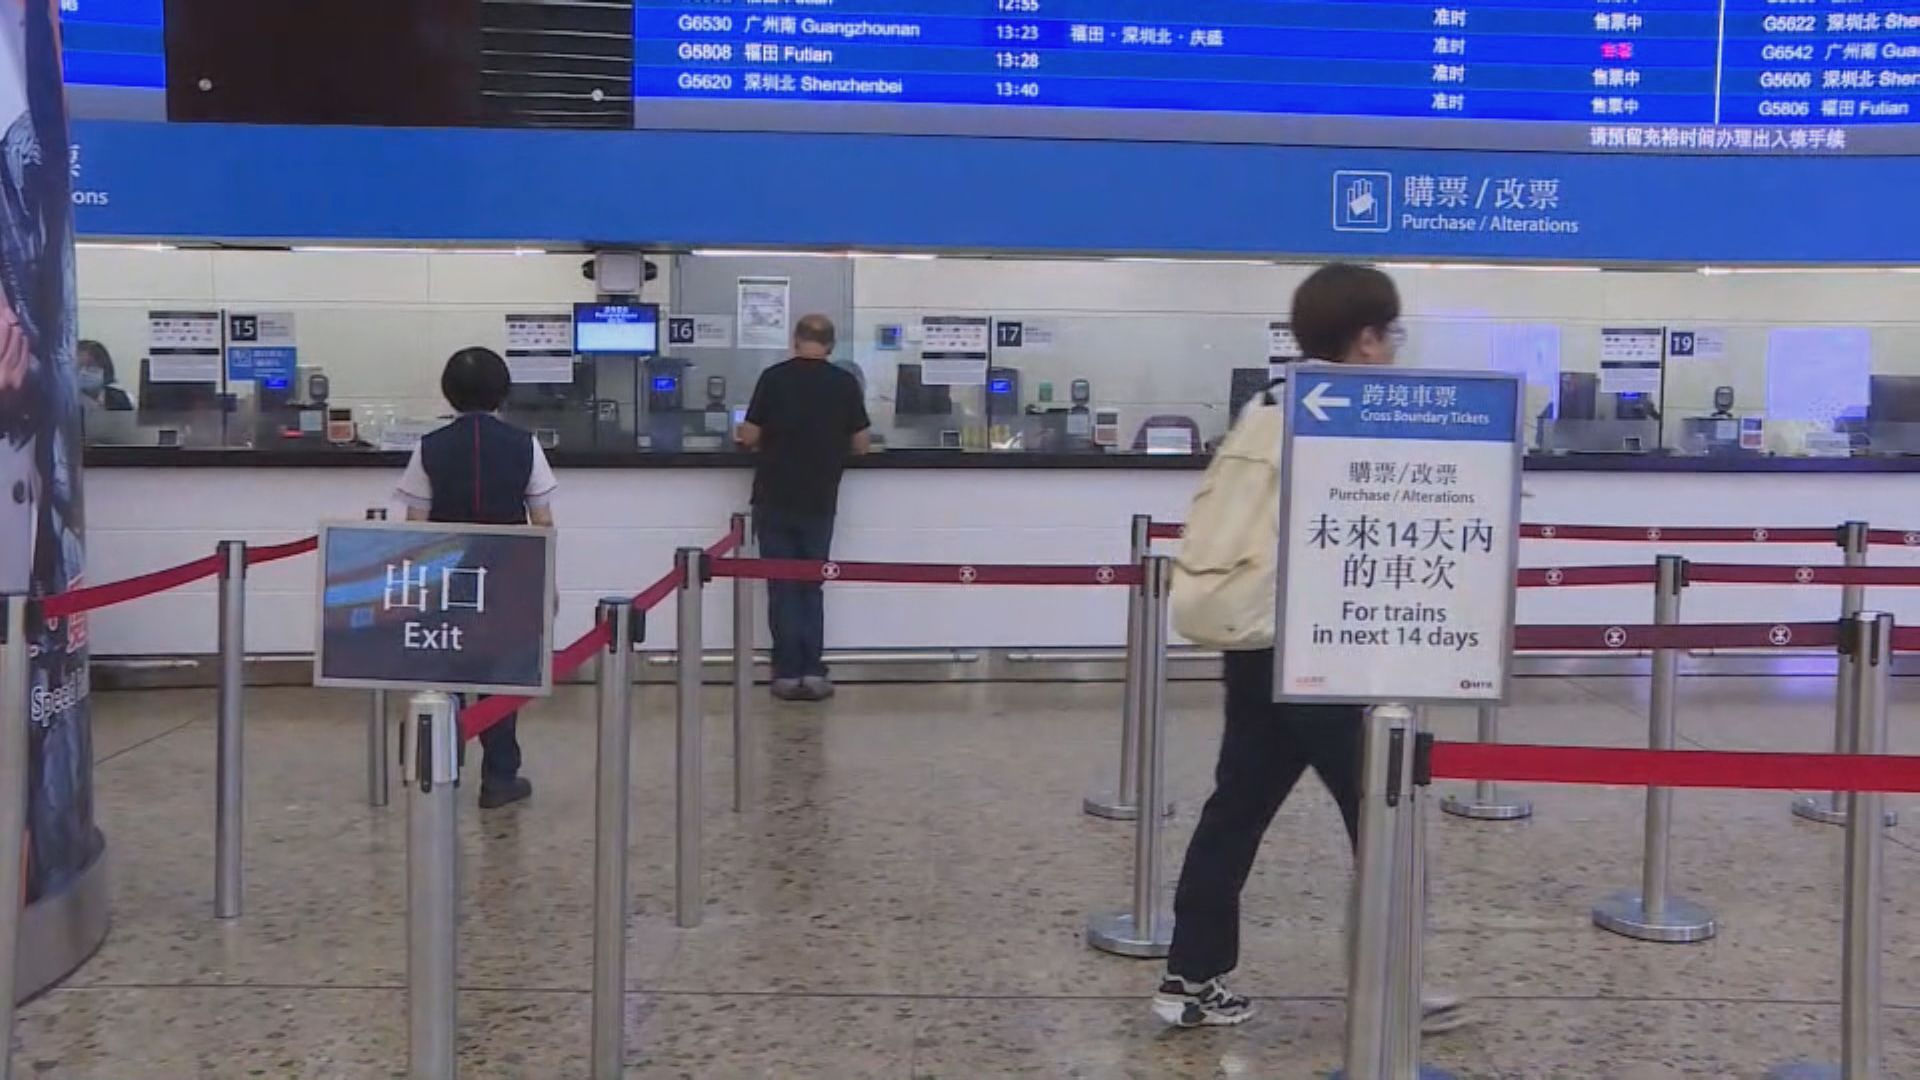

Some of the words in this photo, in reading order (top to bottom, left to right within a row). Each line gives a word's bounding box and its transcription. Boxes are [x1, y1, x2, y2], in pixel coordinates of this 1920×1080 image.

[678, 15, 732, 31] G6530
[744, 16, 797, 34] 广州南
[801, 18, 920, 37] Guangzhounan
[996, 26, 1039, 40] 13:23
[1763, 15, 1816, 31] G5622
[678, 43, 732, 60] G5808
[745, 43, 778, 62] 福田
[784, 46, 832, 63] Futian
[996, 53, 1039, 68] 13:28
[1762, 44, 1814, 60] G6542
[1824, 42, 1877, 61] 广州南
[1882, 43, 1920, 59] Gua
[678, 73, 732, 90] G5620
[744, 73, 796, 91] 深圳北
[801, 77, 902, 94] Shenzhenbei
[996, 82, 1039, 97] 13:40
[1760, 72, 1811, 88] G5606
[1823, 69, 1874, 88] 深圳北
[1758, 101, 1810, 117] G5806
[1859, 101, 1910, 116] Futian
[1402, 214, 1477, 231] Purchase
[1490, 216, 1580, 234] Alterations
[233, 320, 255, 336] 15
[671, 322, 693, 340] 16
[1000, 326, 1021, 343] 17
[1673, 336, 1693, 352] 19
[1362, 383, 1457, 408] 跨境車票
[1361, 408, 1391, 422] Cross
[1393, 409, 1449, 426] Boundary
[1450, 411, 1490, 426] Tickets
[1329, 488, 1391, 502] Purchase
[1402, 490, 1475, 504] Alterations
[1343, 553, 1456, 590] 的車次
[384, 559, 489, 612] 出口
[1342, 602, 1376, 622] For
[1384, 604, 1446, 623] trains
[404, 621, 463, 650] Exit
[1312, 625, 1333, 644] in
[1340, 628, 1391, 646] next
[1399, 628, 1422, 647] 14
[1428, 627, 1479, 651] days
